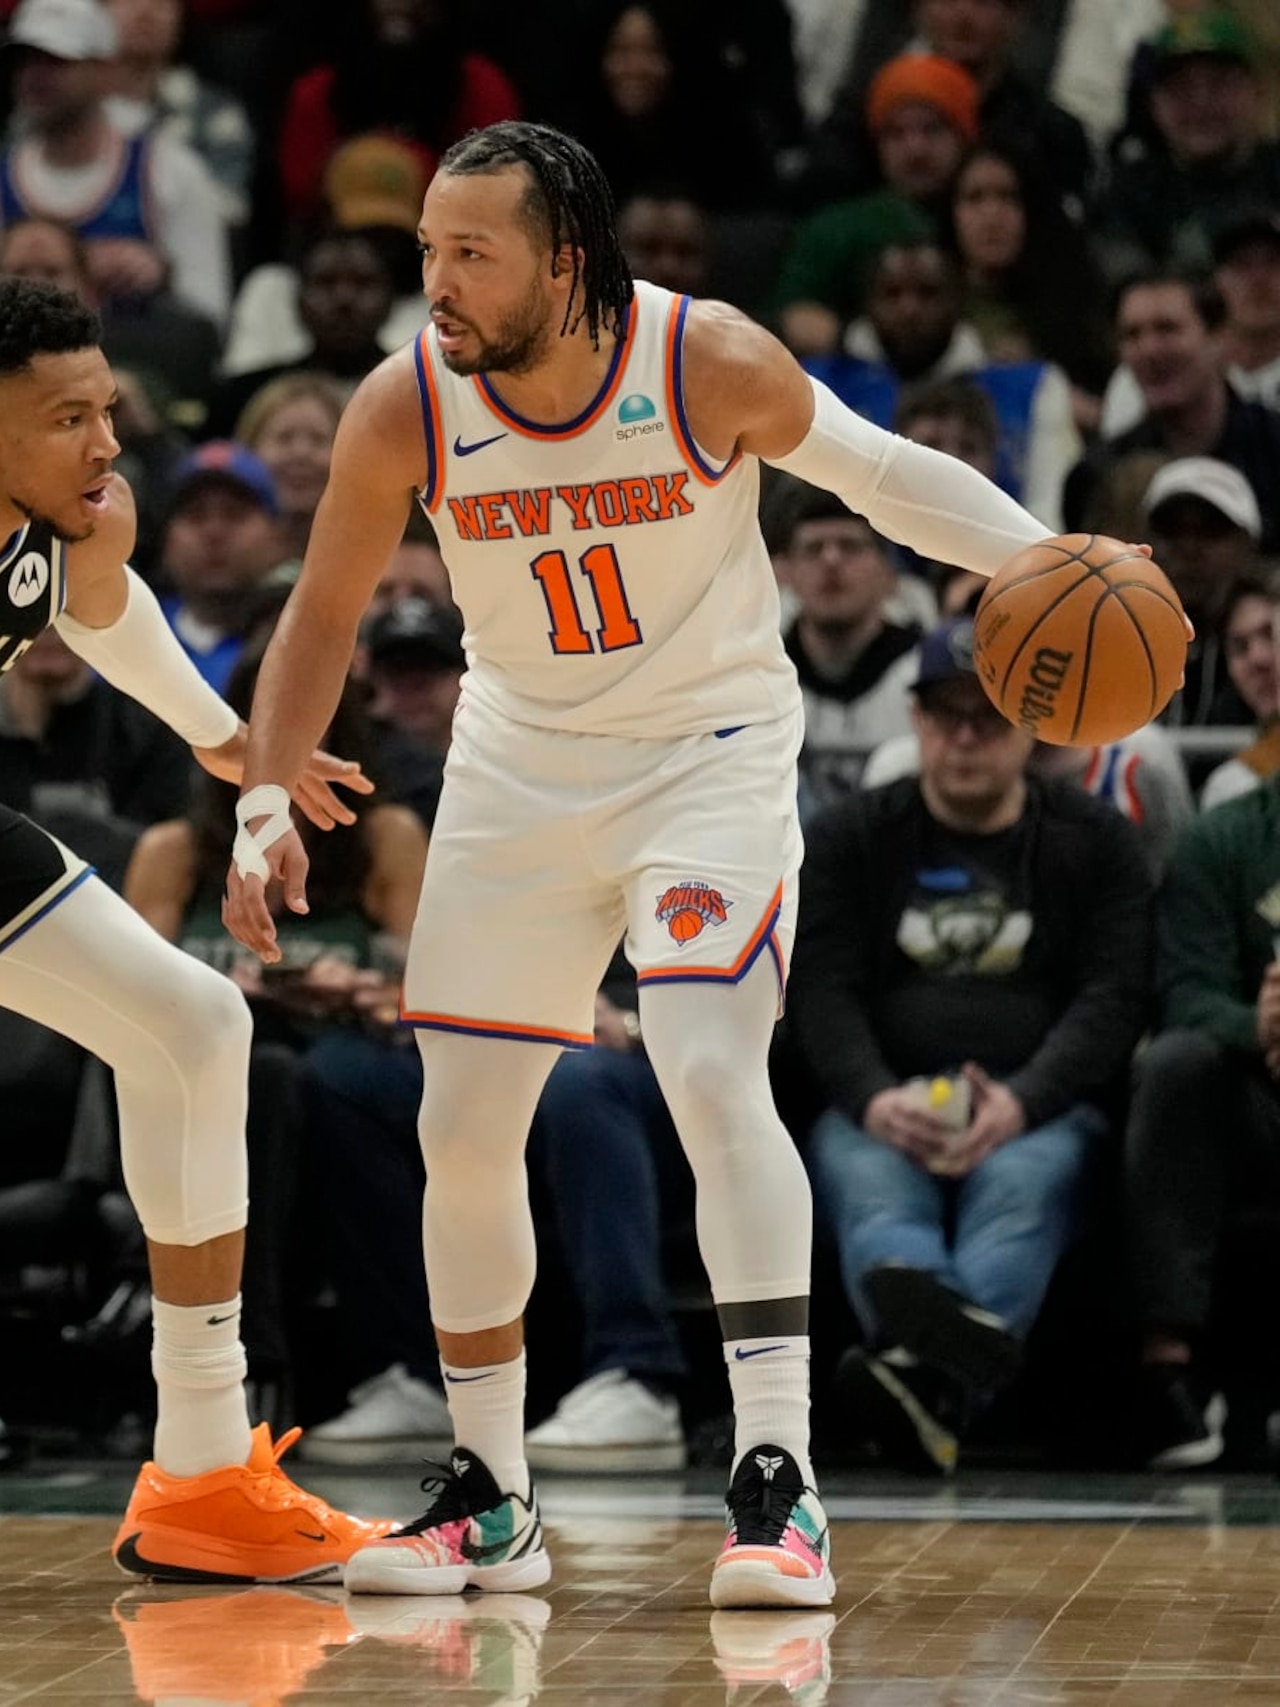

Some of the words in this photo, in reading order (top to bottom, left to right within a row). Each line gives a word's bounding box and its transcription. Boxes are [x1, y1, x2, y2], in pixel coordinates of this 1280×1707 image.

[616, 421, 665, 441] sphere
[447, 485, 552, 541] NEW
[556, 468, 695, 531] YORK
[529, 543, 644, 655] 11
[655, 886, 728, 923] KNICKS
